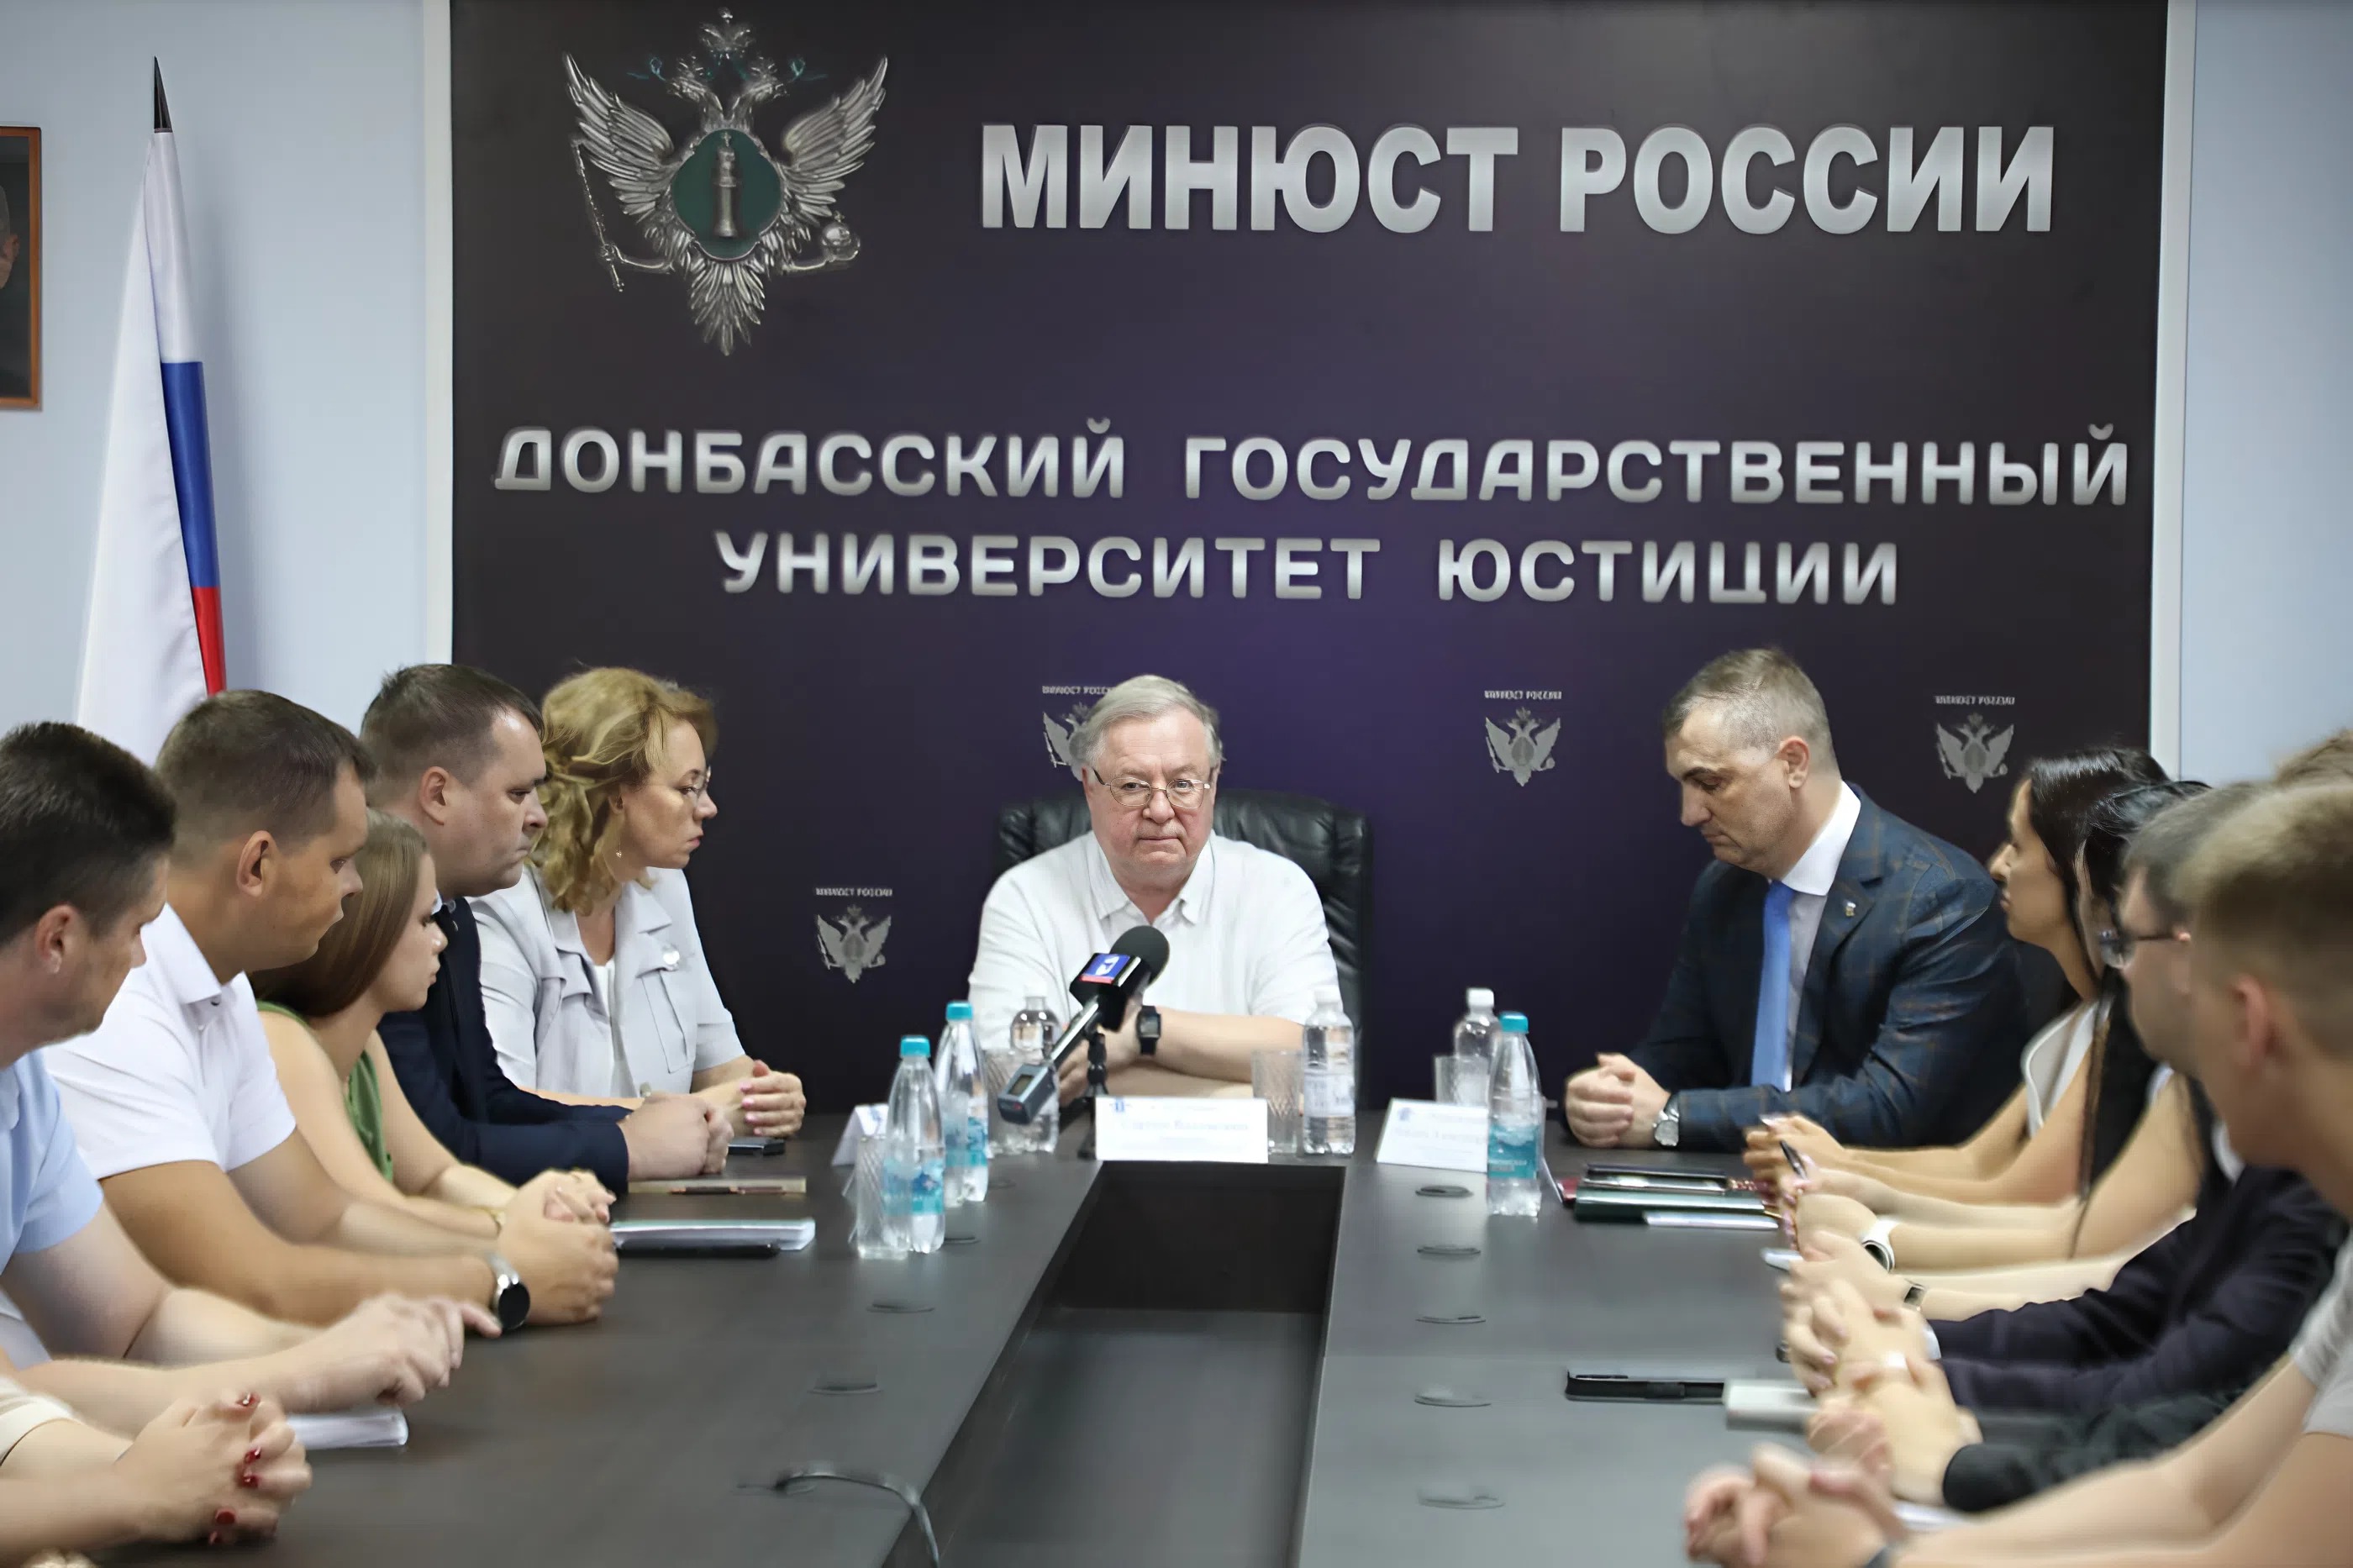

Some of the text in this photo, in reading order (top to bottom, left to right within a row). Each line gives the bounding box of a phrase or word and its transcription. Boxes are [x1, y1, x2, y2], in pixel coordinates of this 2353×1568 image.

[981, 124, 2055, 235] МИНЮСТ РОССИИ
[493, 418, 2129, 506] ДОНБАССКИЙ ГОСУДАРСТВЕННЫЙ
[715, 532, 1898, 605] УНИВЕРСИТЕТ ЮСТИЦИИ
